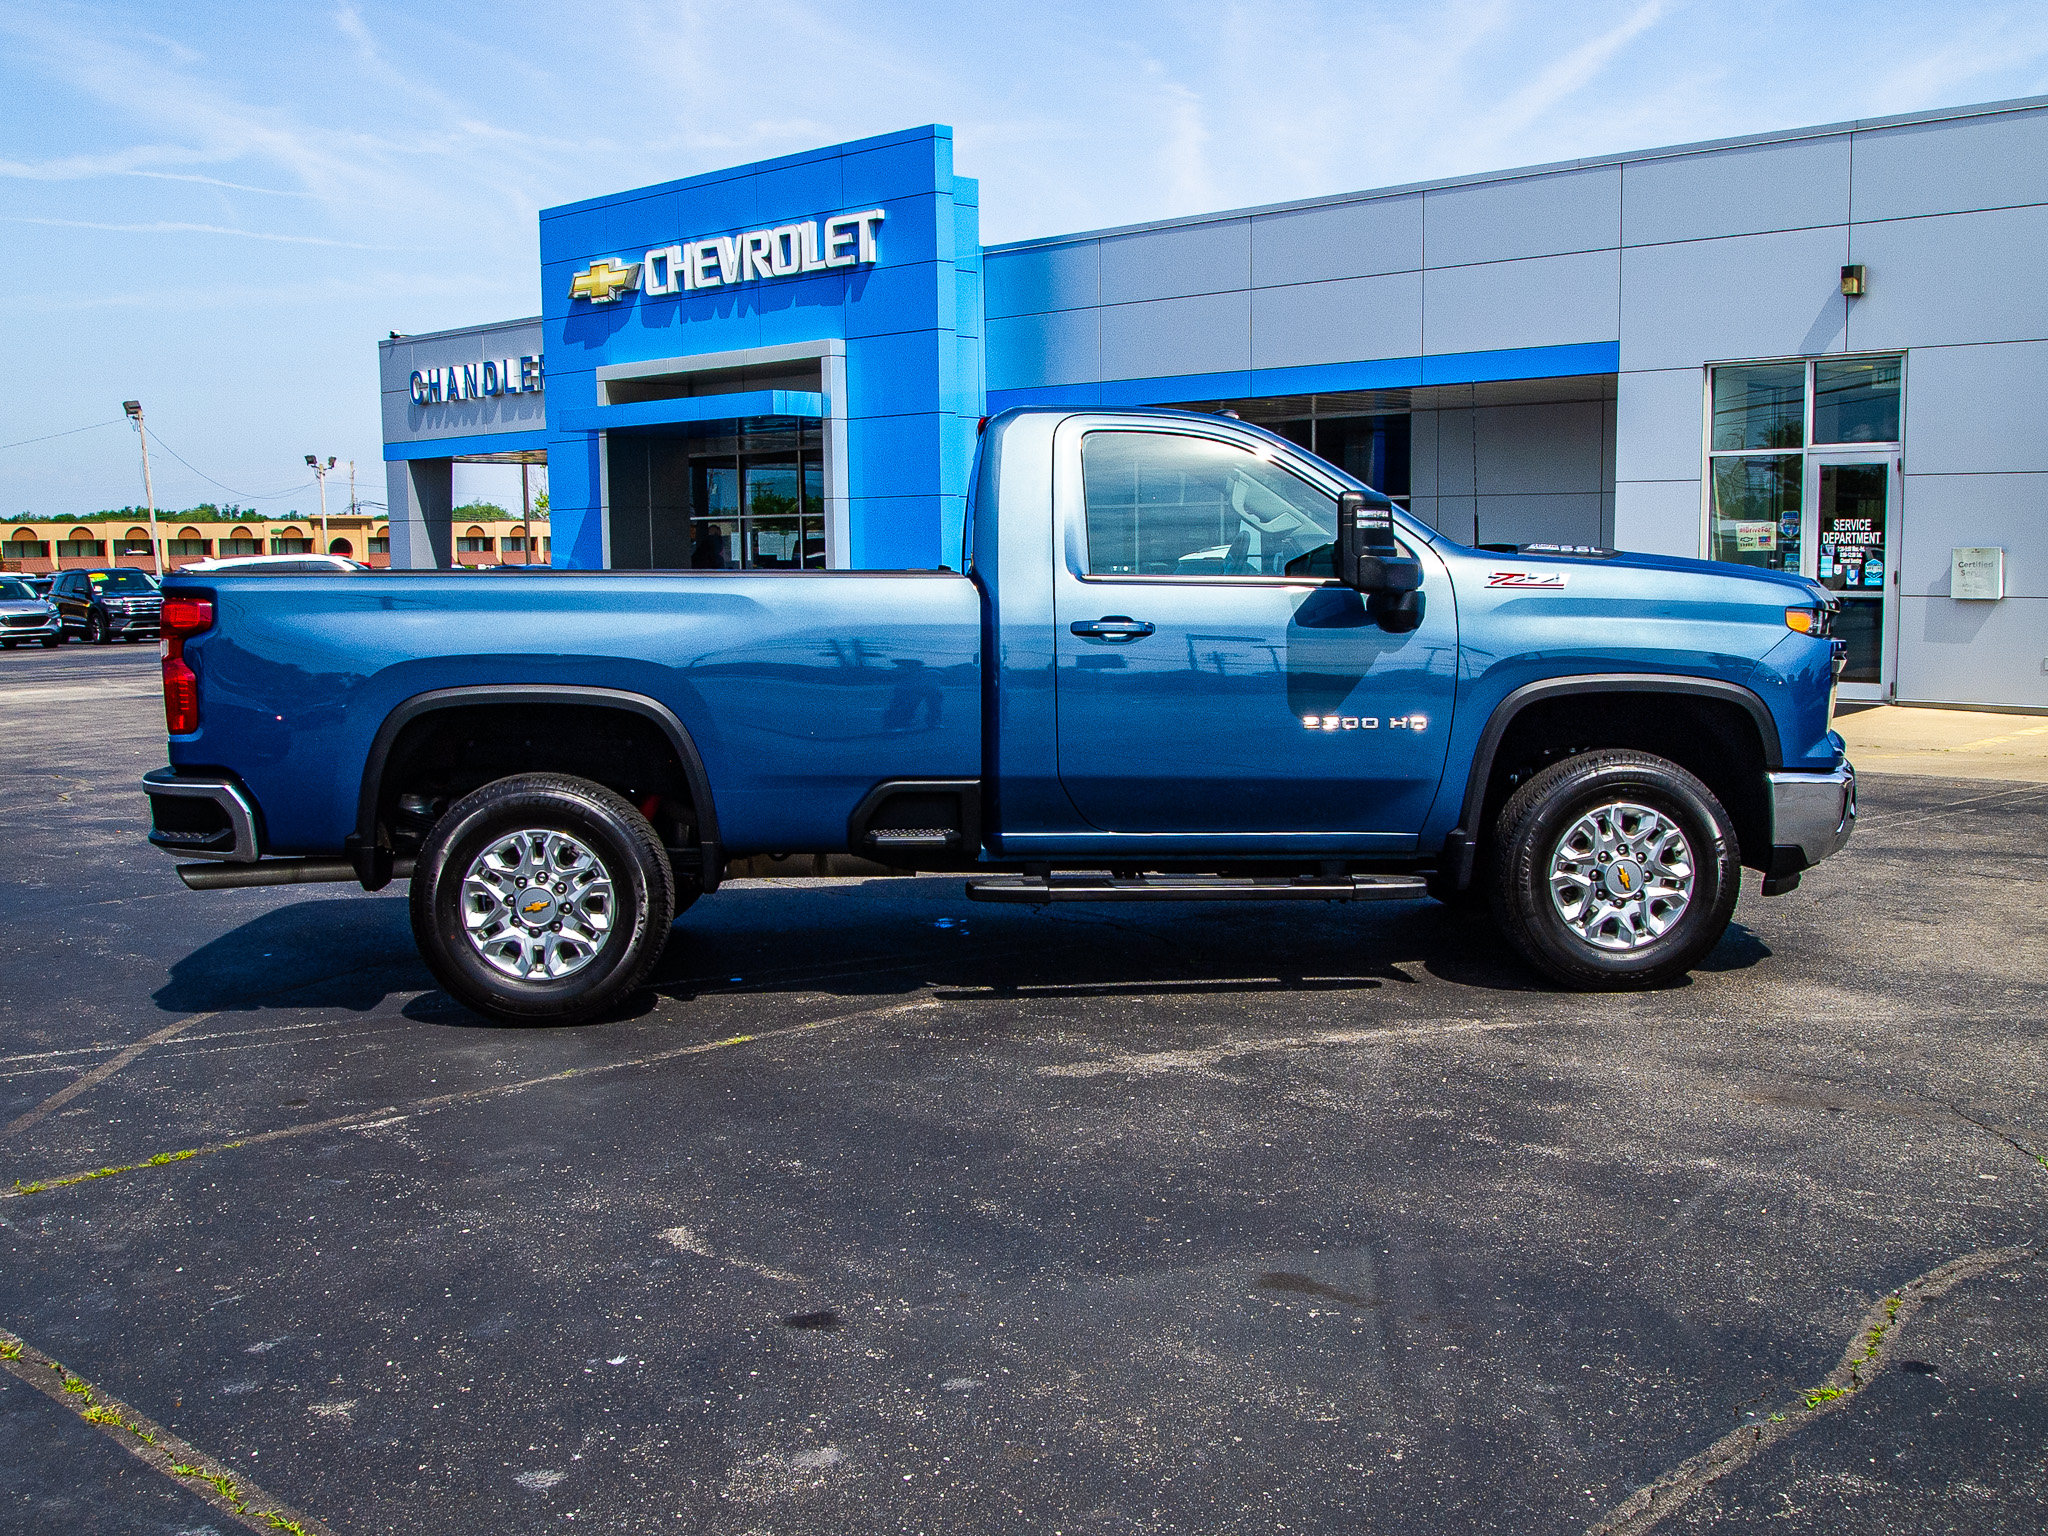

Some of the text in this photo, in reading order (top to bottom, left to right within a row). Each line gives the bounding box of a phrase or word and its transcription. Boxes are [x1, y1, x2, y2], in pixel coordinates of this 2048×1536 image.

[644, 208, 886, 297] CHEVROLET
[1833, 518, 1872, 531] SERVICE
[1822, 531, 1882, 544] DEPARTMENT
[1389, 715, 1428, 730] HD
